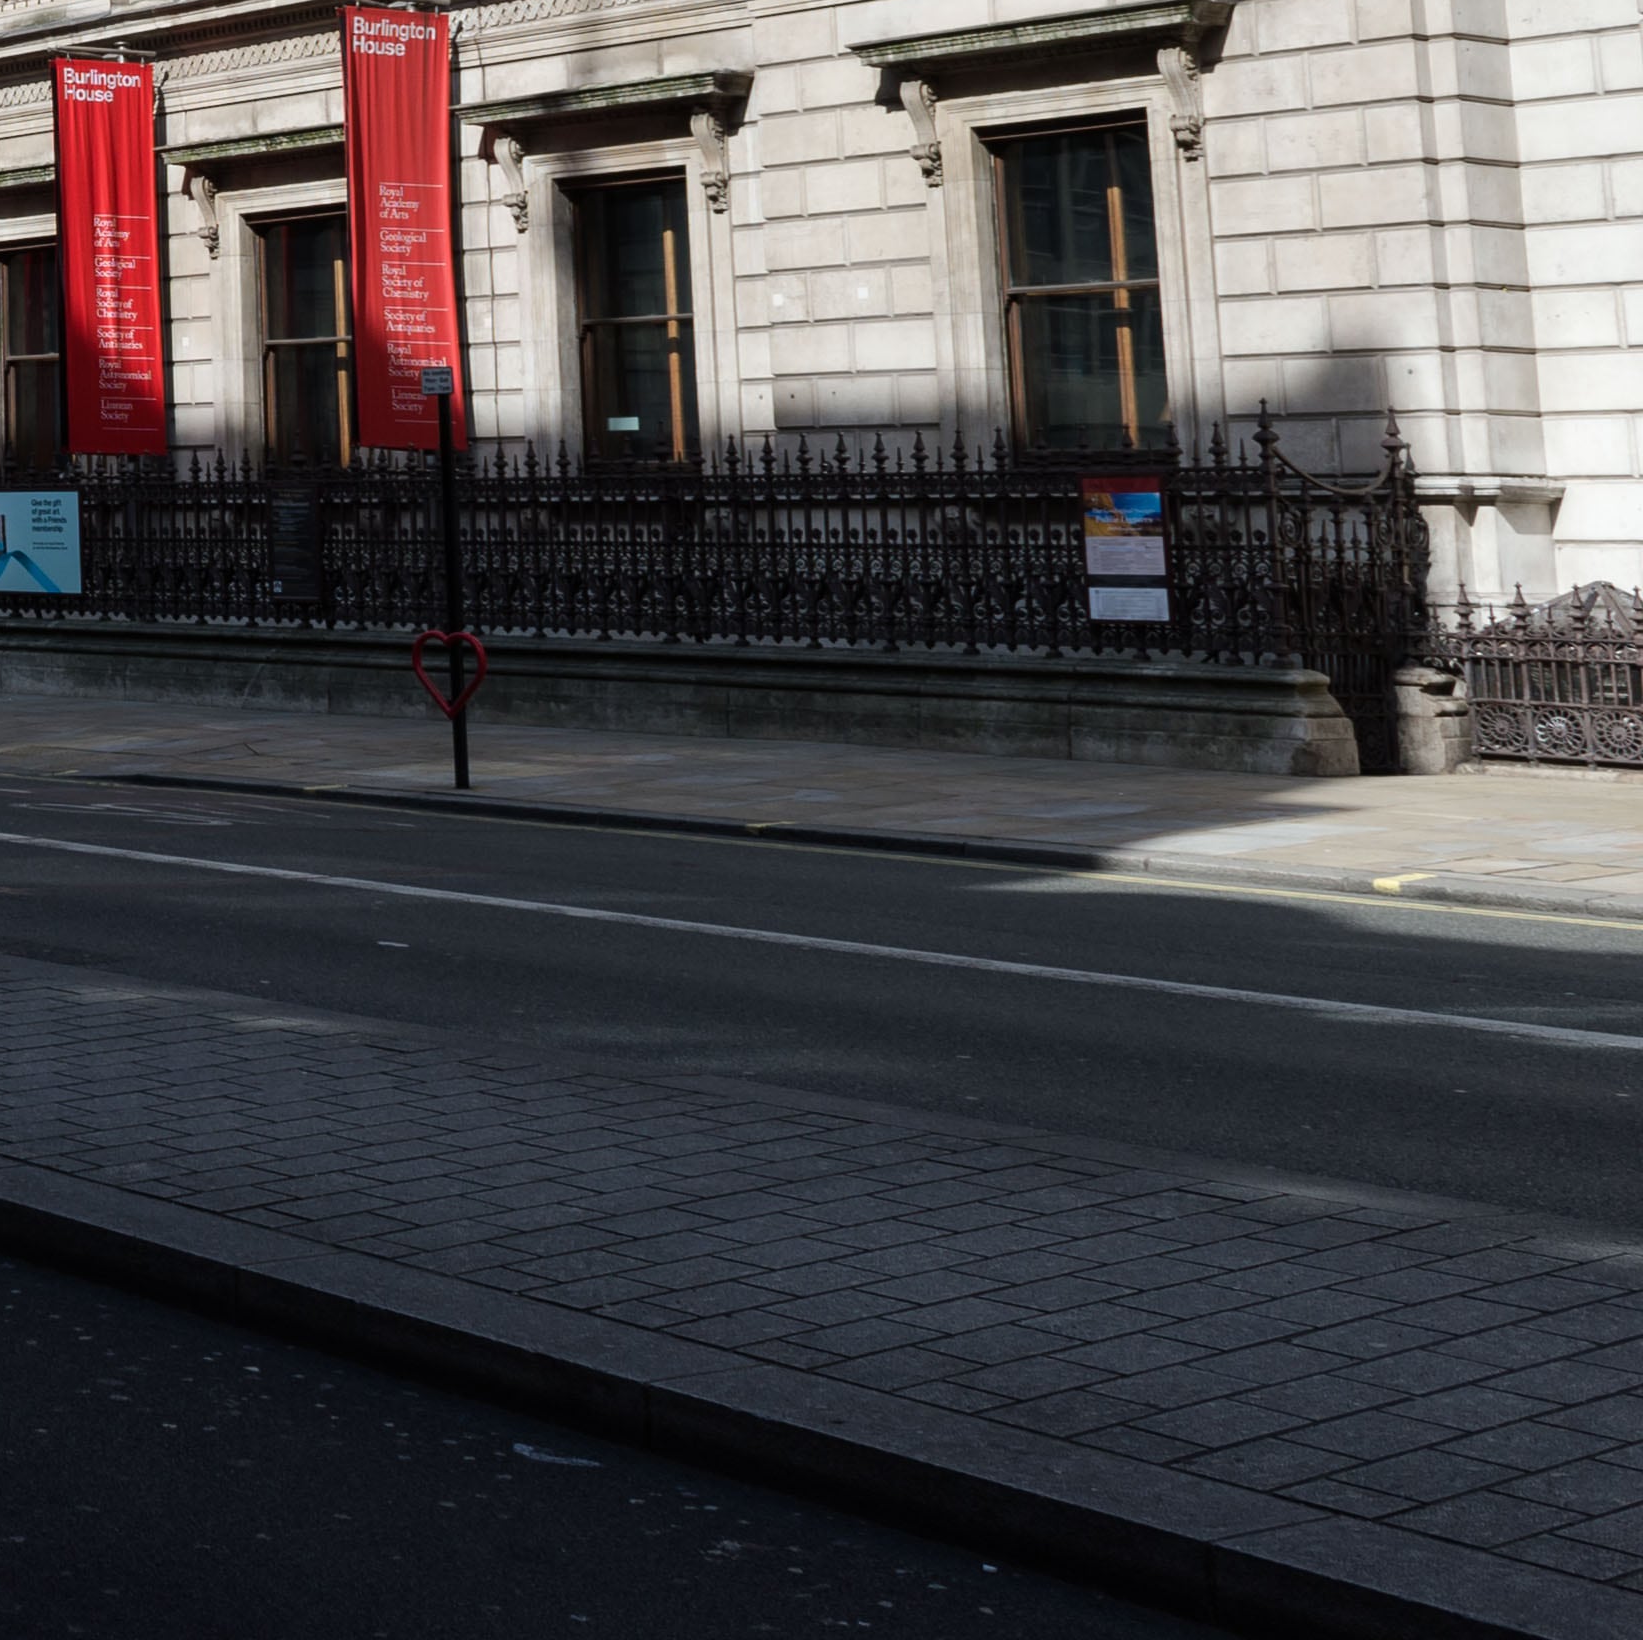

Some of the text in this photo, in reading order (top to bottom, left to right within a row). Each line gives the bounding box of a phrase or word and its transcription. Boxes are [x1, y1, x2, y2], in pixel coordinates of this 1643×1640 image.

[353, 16, 436, 42] Burlington
[353, 35, 406, 57] House
[64, 67, 141, 90] Burlington
[64, 84, 114, 103] House
[379, 184, 404, 199] Royal
[379, 196, 420, 212] Academy
[379, 208, 410, 219] of Arts
[94, 217, 117, 231] Royal
[94, 227, 131, 241] Academy
[380, 230, 427, 244] Geological
[94, 238, 121, 248] of Arts
[380, 241, 413, 256] Society
[95, 258, 136, 270] Geological
[382, 263, 406, 277] Royal
[95, 268, 123, 281] Society
[382, 274, 426, 289] Society of
[97, 287, 119, 301] Royal
[382, 287, 429, 302] Chemistry
[97, 298, 134, 310] Society of
[97, 309, 138, 322] Chemistry
[384, 309, 427, 323] Society of
[97, 328, 136, 342] Society of
[386, 321, 436, 336] Antiquaries
[99, 339, 144, 351] Antiquaries
[387, 343, 412, 357] Royal
[99, 358, 122, 372] Royal
[388, 354, 447, 367] Astronomical
[100, 368, 152, 380] Astronomical
[387, 366, 421, 380] Society
[99, 379, 127, 392] Society
[101, 399, 134, 410] Linnean
[391, 400, 429, 415] Society
[101, 410, 129, 424] Society
